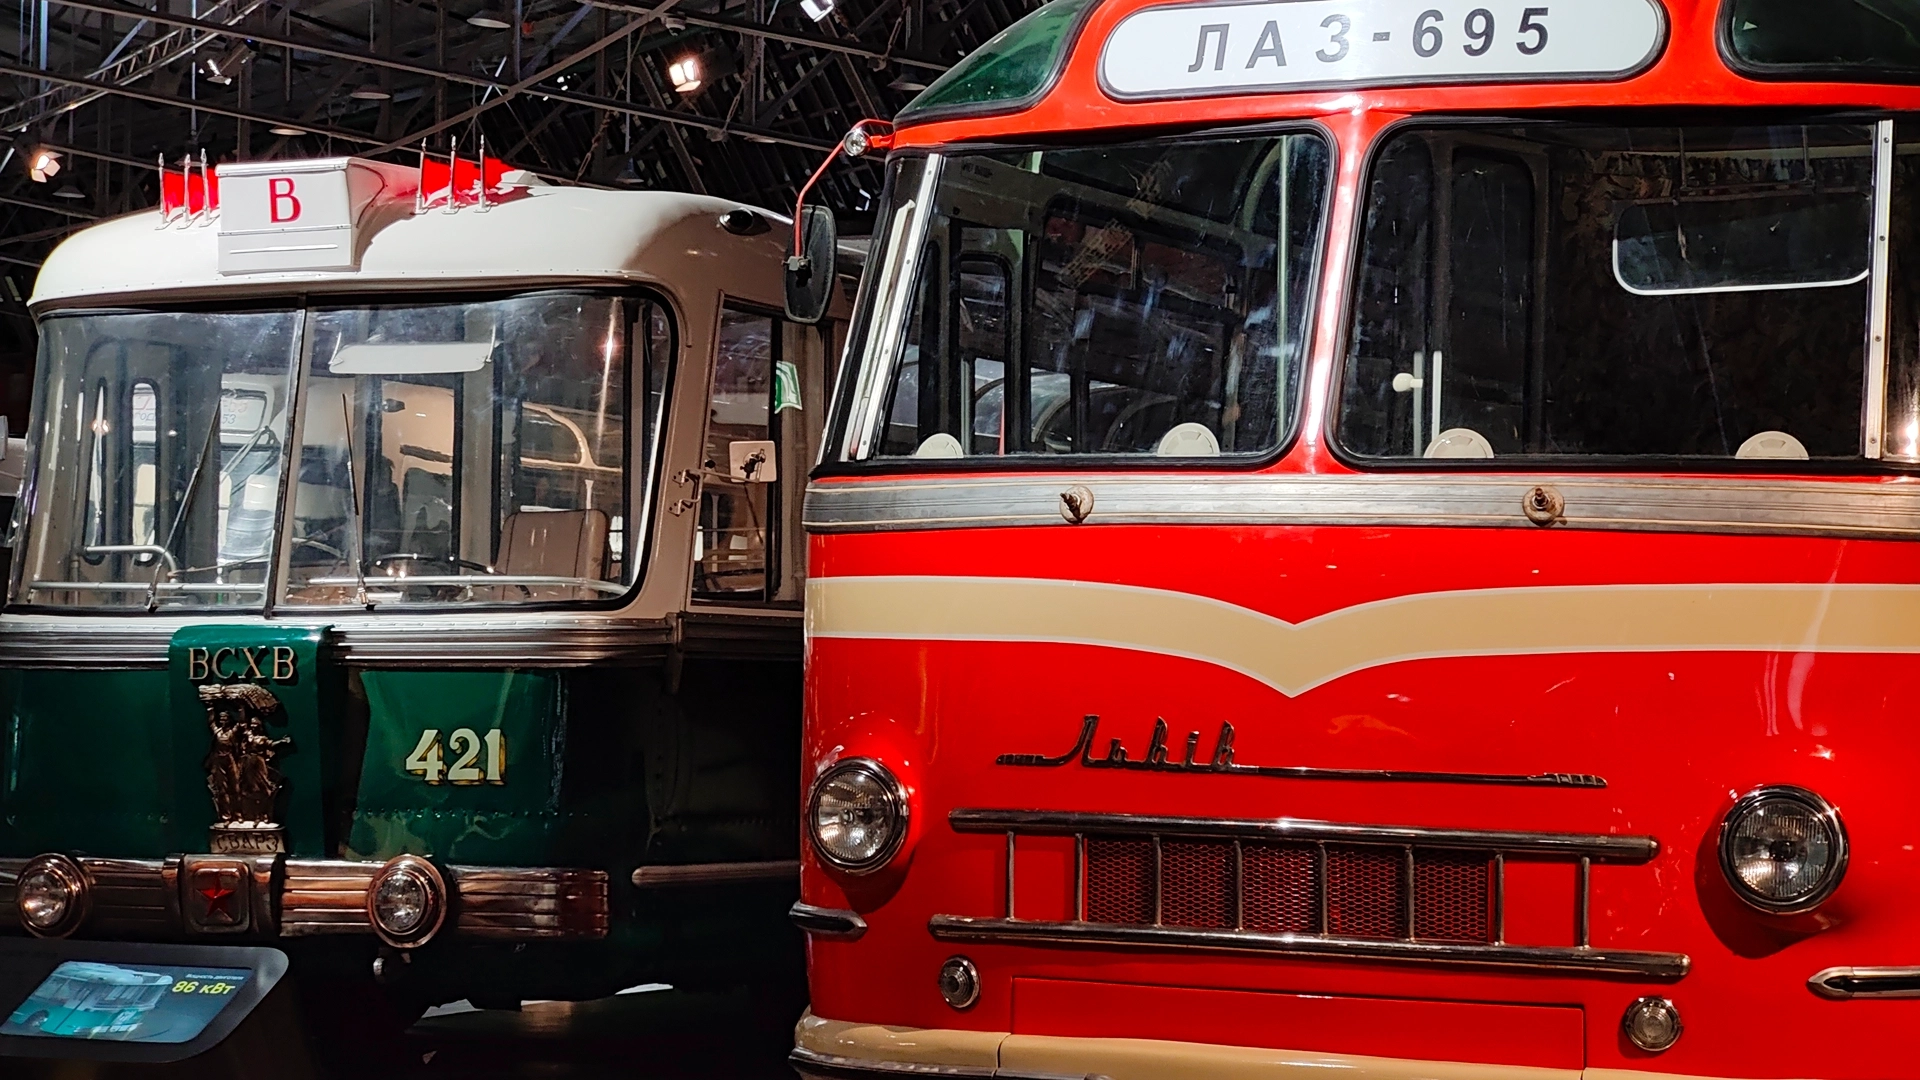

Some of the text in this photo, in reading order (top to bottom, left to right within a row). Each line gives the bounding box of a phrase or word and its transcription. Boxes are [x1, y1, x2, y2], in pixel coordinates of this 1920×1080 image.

[1187, 6, 1549, 73] ЛАЗ-695
[268, 177, 302, 224] В
[187, 645, 296, 680] ВСХВ
[405, 727, 506, 786] 421
[216, 834, 280, 852] СВАРЗ
[171, 980, 236, 995] 86 кВт
